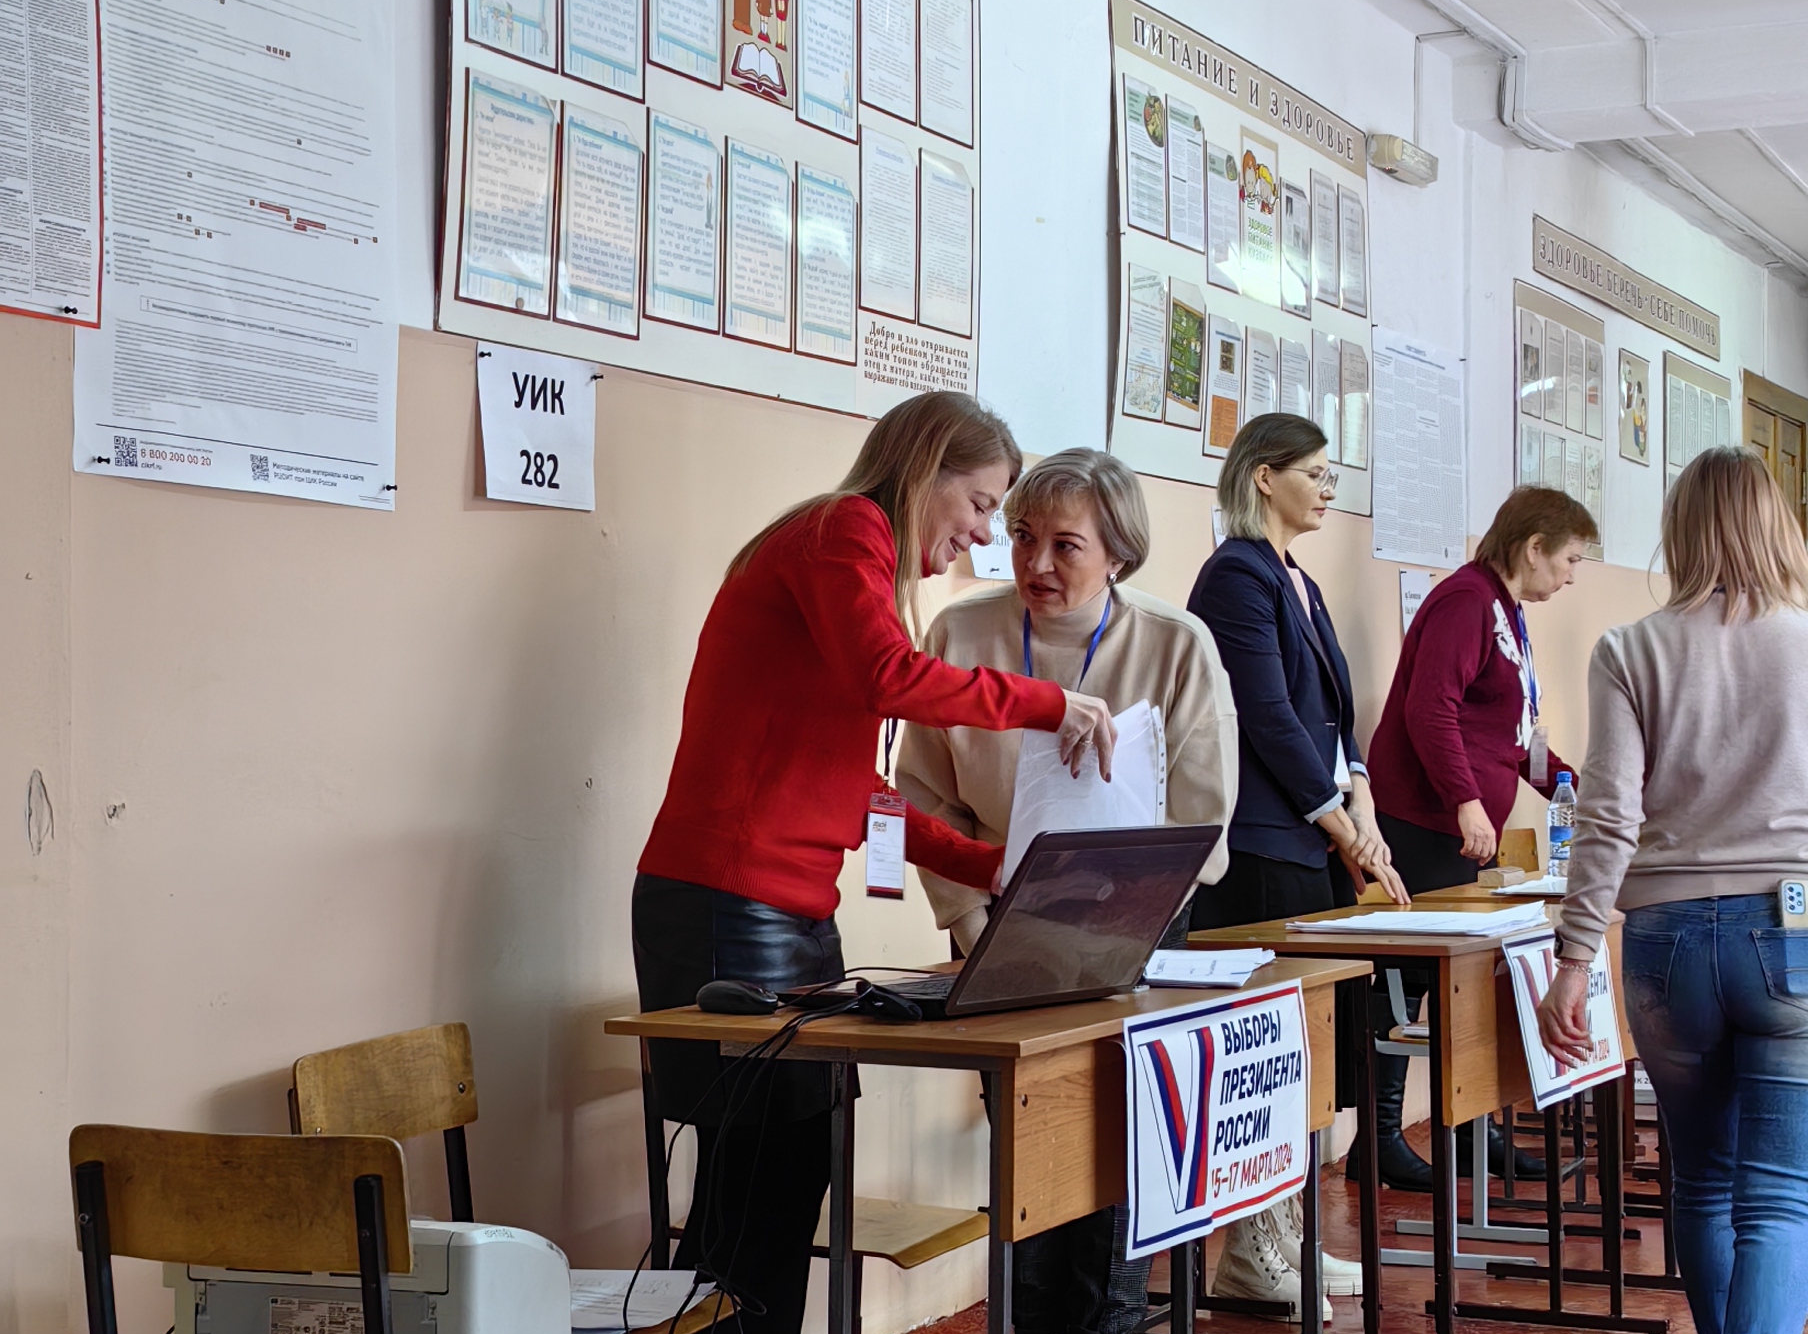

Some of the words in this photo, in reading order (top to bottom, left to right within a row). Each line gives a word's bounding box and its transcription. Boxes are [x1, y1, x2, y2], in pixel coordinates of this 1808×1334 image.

[1133, 15, 1238, 95] ПИТАНИЕ
[1249, 77, 1260, 108] И
[1269, 90, 1354, 162] ЗДОРОВЬЕ
[1539, 234, 1603, 288] ЗДОРОВЬЕ
[1606, 268, 1643, 310] БЕРЕЧЬ
[1650, 294, 1676, 326] СЕБЕ
[1678, 308, 1717, 347] ПОМОЧЬ
[869, 321, 895, 341] Добро
[920, 339, 969, 359] открывается
[891, 342, 928, 360] ребенком
[929, 354, 945, 365] уже
[863, 359, 881, 371] отец
[941, 377, 968, 392] чувства
[864, 347, 890, 361] каким
[892, 354, 918, 369] тоном
[920, 361, 968, 380] обращается
[511, 371, 566, 416] УИК
[169, 451, 185, 463] 200
[187, 454, 199, 465] 00
[201, 455, 212, 467] 20
[519, 449, 561, 490] 282
[1220, 1009, 1281, 1057] ВЫБОРЫ
[1219, 1049, 1302, 1106] ПРЕЗИДЕНТА
[1213, 1104, 1272, 1157] РОССИИ
[1240, 1149, 1273, 1190] МАРТА
[1273, 1141, 1293, 1178] 2024
